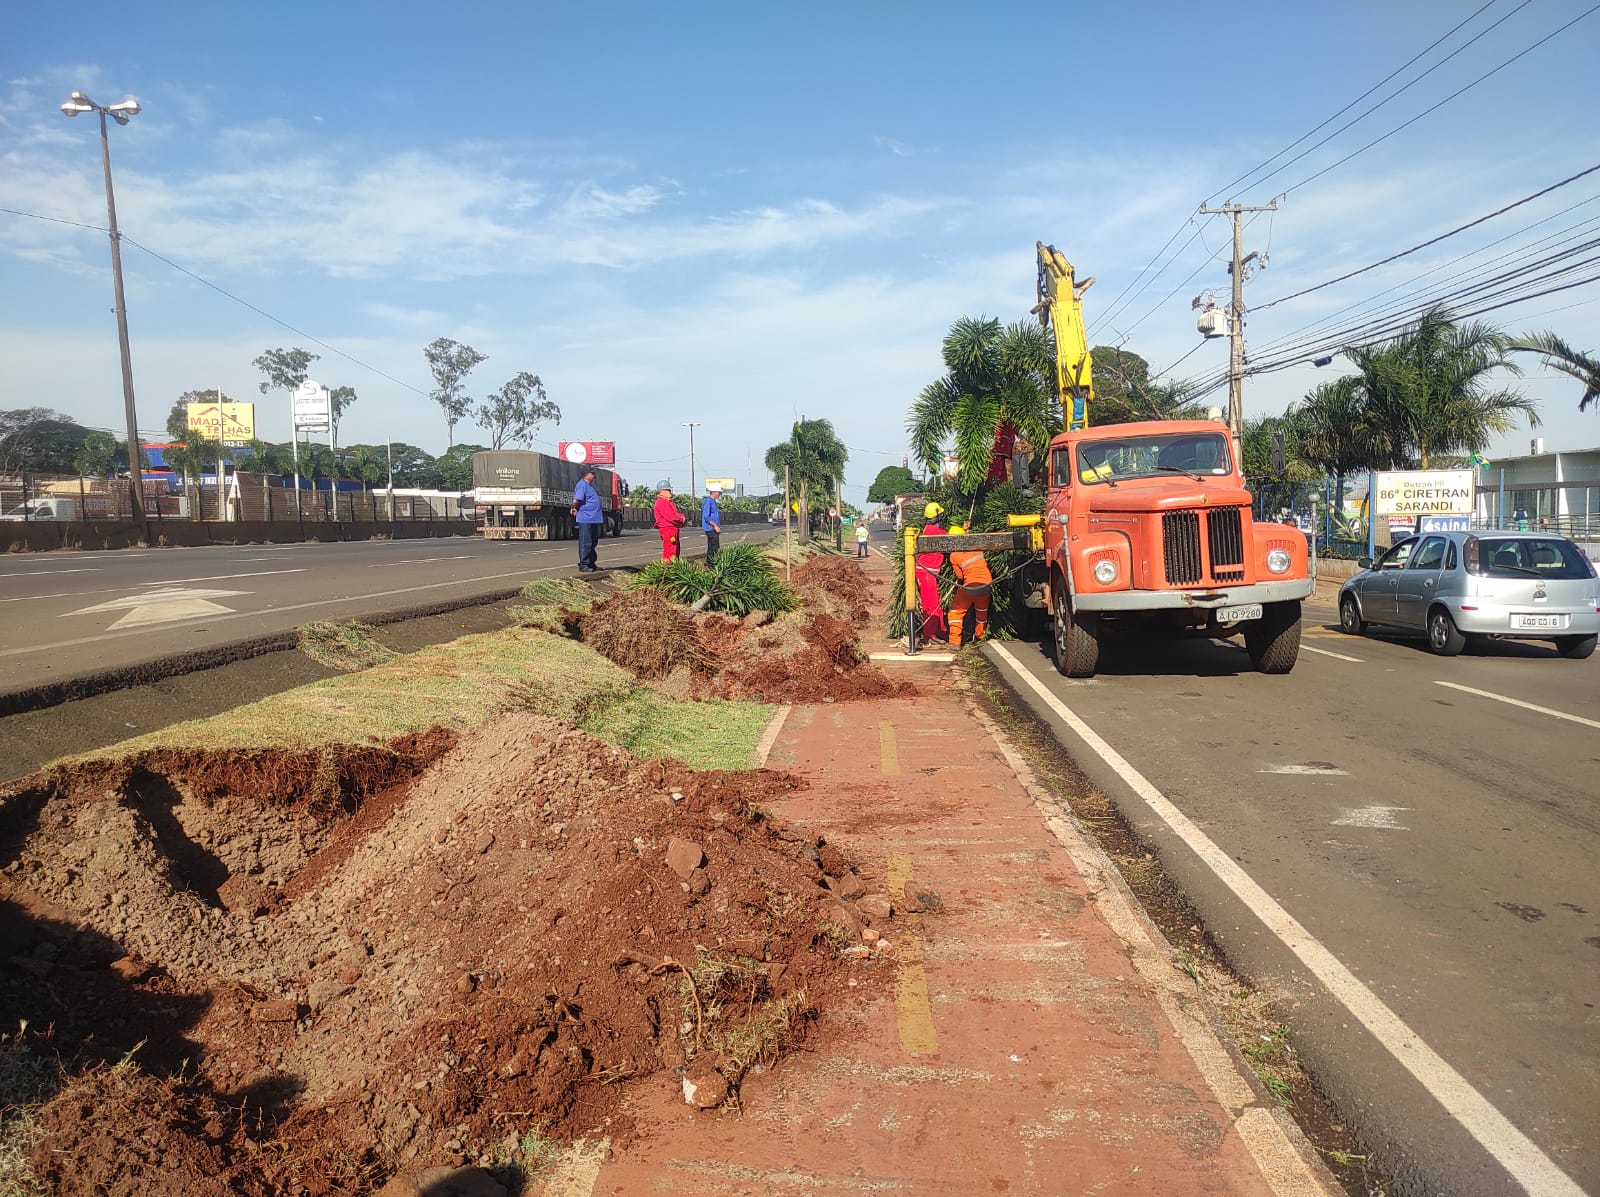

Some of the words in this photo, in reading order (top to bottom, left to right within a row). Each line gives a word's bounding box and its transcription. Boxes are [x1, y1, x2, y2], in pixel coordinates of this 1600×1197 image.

[190, 417, 227, 426] MADE
[205, 426, 251, 435] TELHAS
[1380, 489, 1400, 499] 86ª
[1403, 488, 1469, 499] CIRETRAN
[1395, 501, 1453, 511] SARANDI
